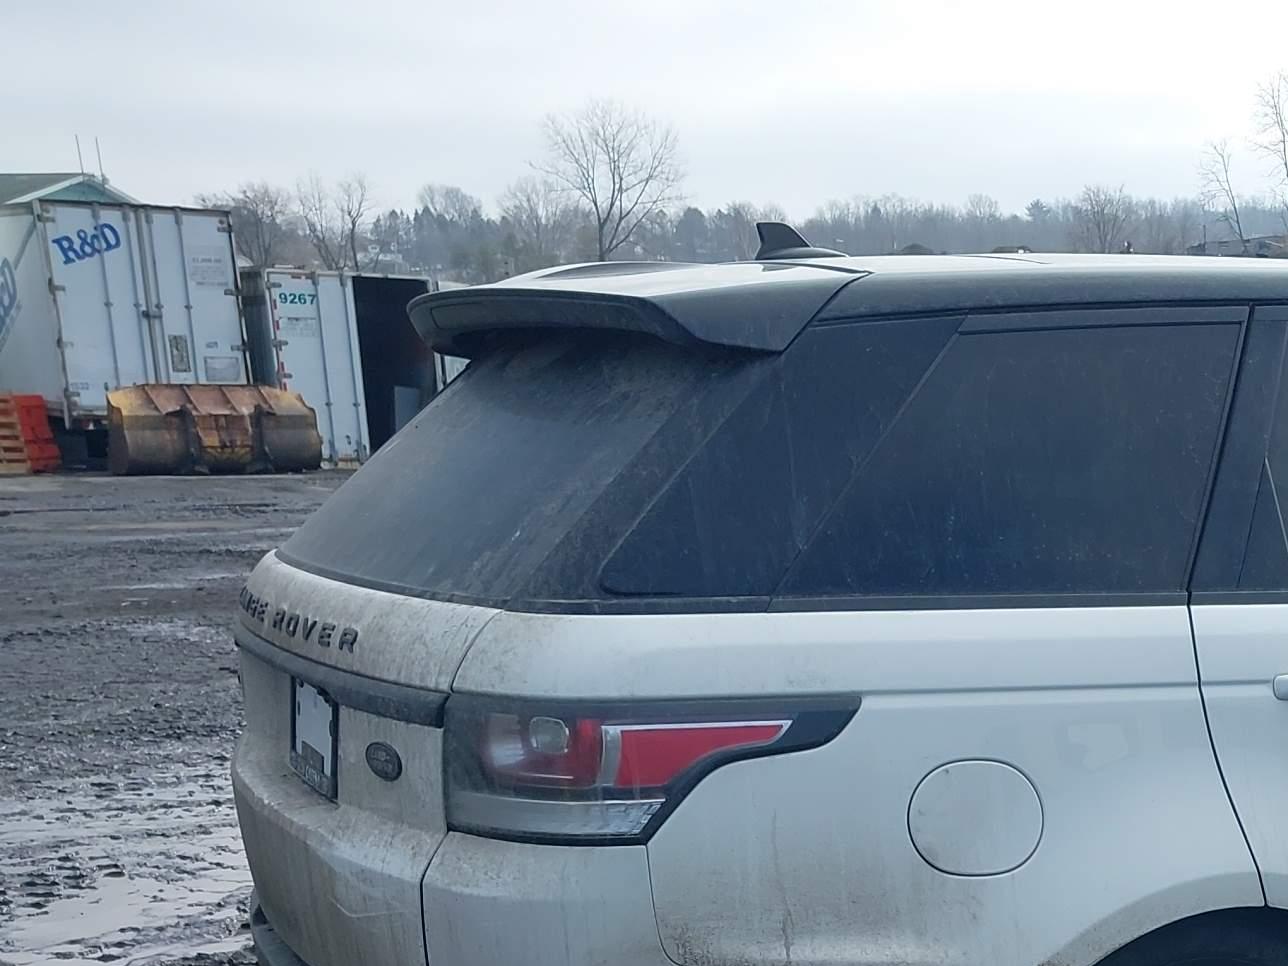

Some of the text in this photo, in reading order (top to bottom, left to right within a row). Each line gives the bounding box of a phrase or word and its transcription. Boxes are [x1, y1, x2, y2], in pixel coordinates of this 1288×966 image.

[51, 222, 121, 265] R&D
[279, 292, 317, 305] 9267
[272, 607, 359, 654] ROVER
